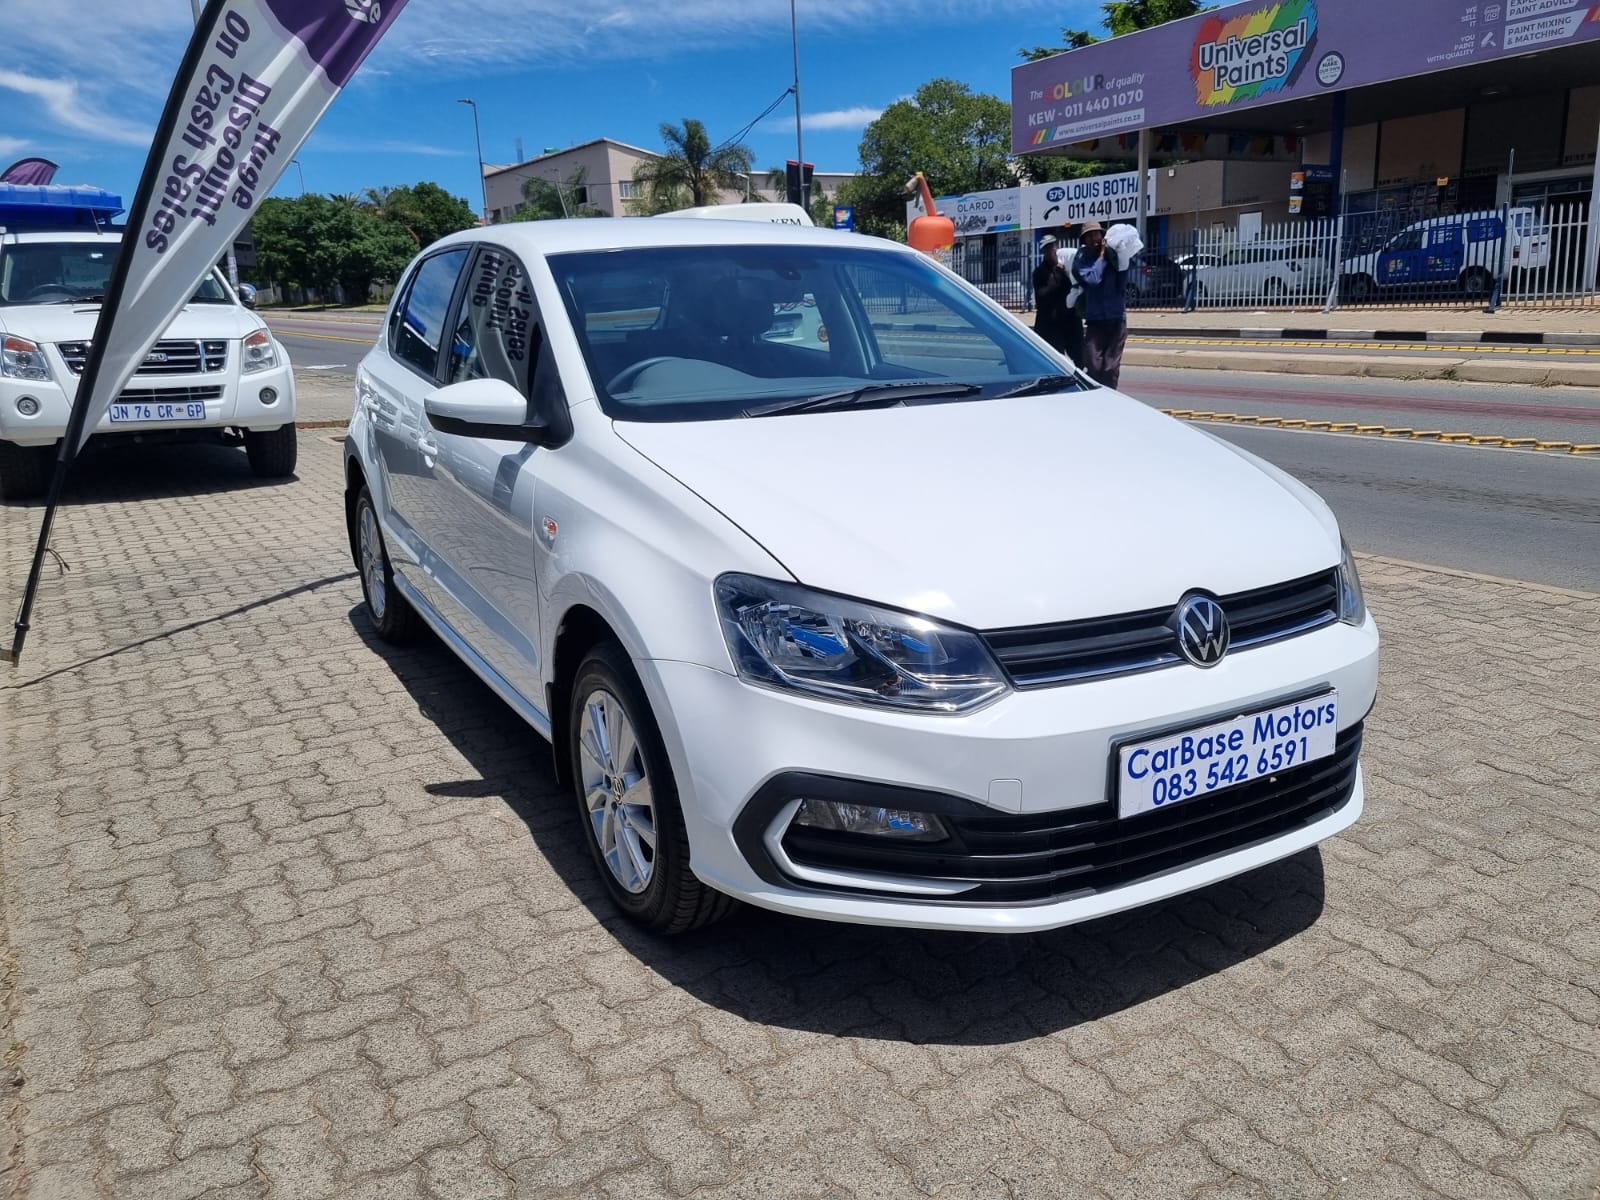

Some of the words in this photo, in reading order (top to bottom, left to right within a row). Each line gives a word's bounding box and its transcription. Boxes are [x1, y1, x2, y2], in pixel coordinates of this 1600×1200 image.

[1508, 24, 1535, 36] PAINT
[1537, 16, 1572, 29] MIXING
[1510, 4, 1537, 16] PAINT
[215, 9, 251, 60] On
[1200, 21, 1306, 69] Universal
[1507, 37, 1513, 45] &
[1515, 27, 1565, 43] MATCHING
[1030, 90, 1043, 101] The
[1044, 74, 1104, 102] COLOUR
[1106, 78, 1115, 90] of
[1116, 72, 1145, 89] quality
[1216, 52, 1286, 89] Paints
[182, 63, 235, 151] Cash
[1028, 109, 1056, 127] KEW
[1065, 102, 1083, 118] 011
[1086, 97, 1110, 113] 440
[1112, 89, 1144, 107] 1070
[1058, 114, 1141, 137] www.universalpaints.co.za
[191, 72, 273, 227] Discount
[232, 121, 282, 211] Huge
[146, 154, 207, 254] Sales
[957, 200, 994, 212] OLAROD
[1048, 189, 1064, 200] 575
[1067, 181, 1100, 201] LOUIS
[1068, 202, 1085, 219] 011
[1089, 199, 1112, 217] 440
[135, 404, 151, 419] 76
[158, 404, 174, 418] CR
[187, 403, 203, 418] GP
[1127, 728, 1244, 780] CarBase
[1252, 703, 1336, 745] Motors
[1152, 769, 1197, 806] 083
[1205, 754, 1249, 791] 542
[1256, 737, 1308, 774] 6591
